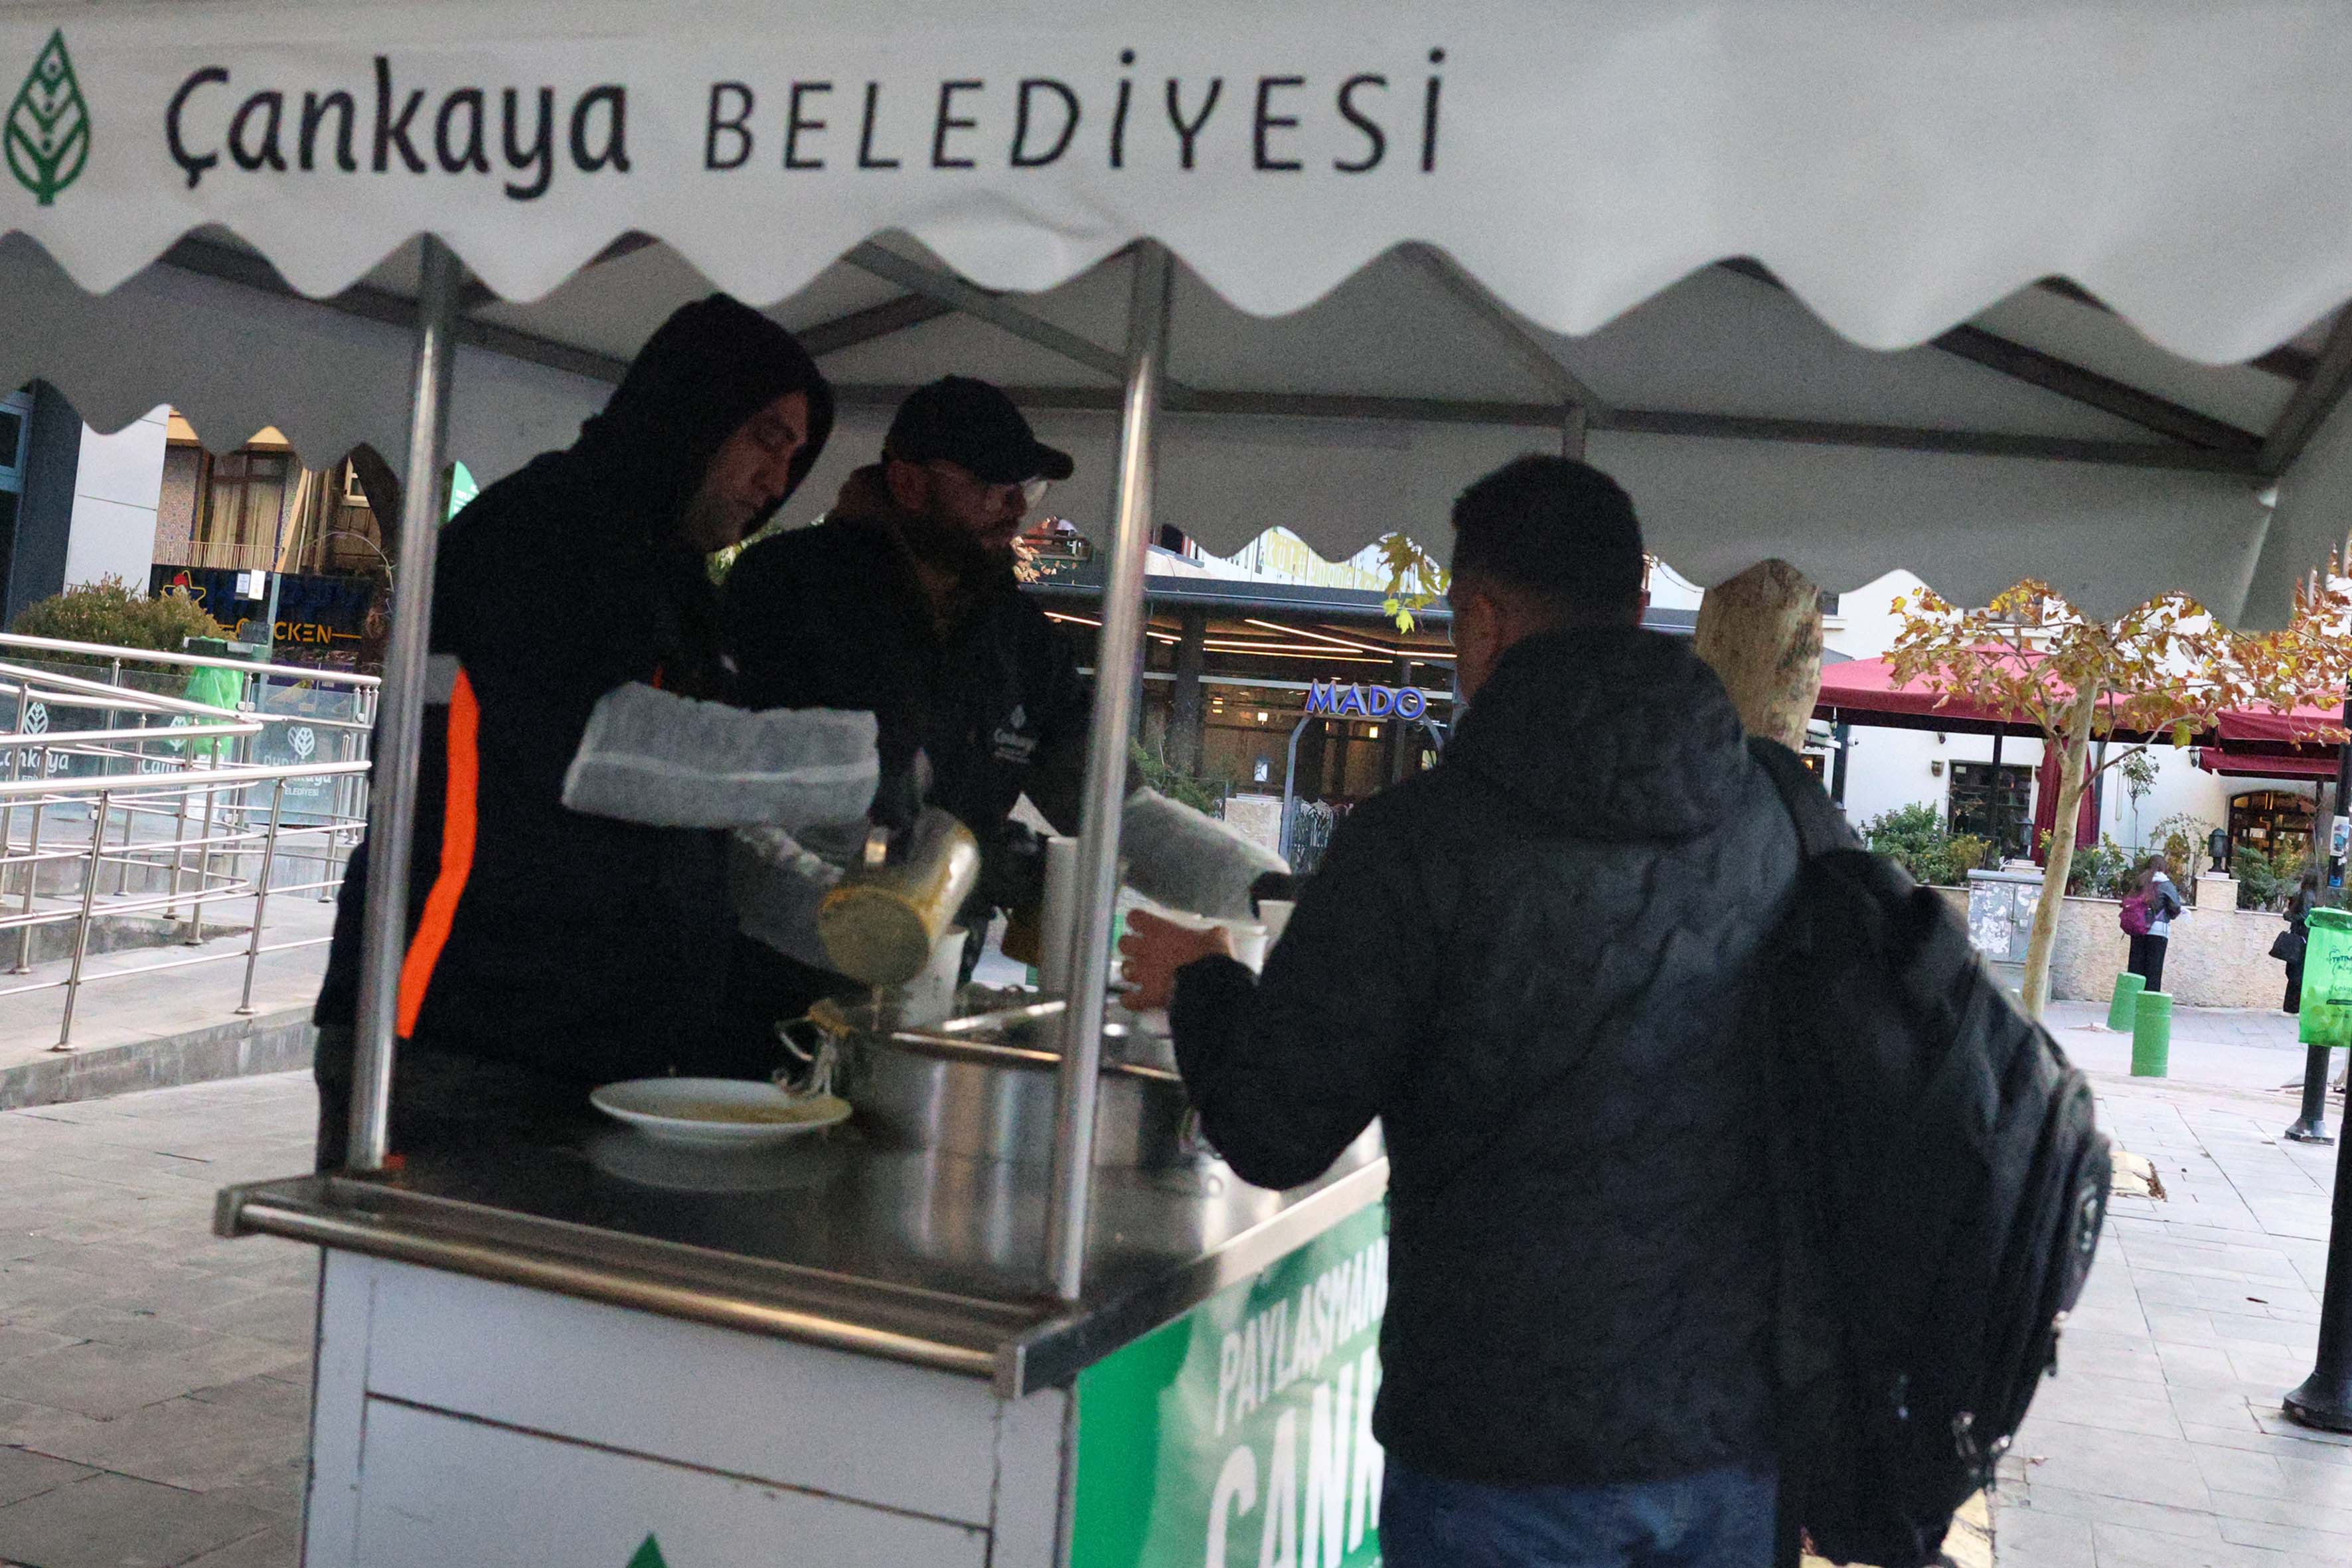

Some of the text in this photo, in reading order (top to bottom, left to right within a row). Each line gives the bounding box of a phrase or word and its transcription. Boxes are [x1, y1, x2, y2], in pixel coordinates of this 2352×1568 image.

[165, 48, 1447, 202] Çankaya BELEDİYESİ
[1304, 678, 1427, 720] MADO
